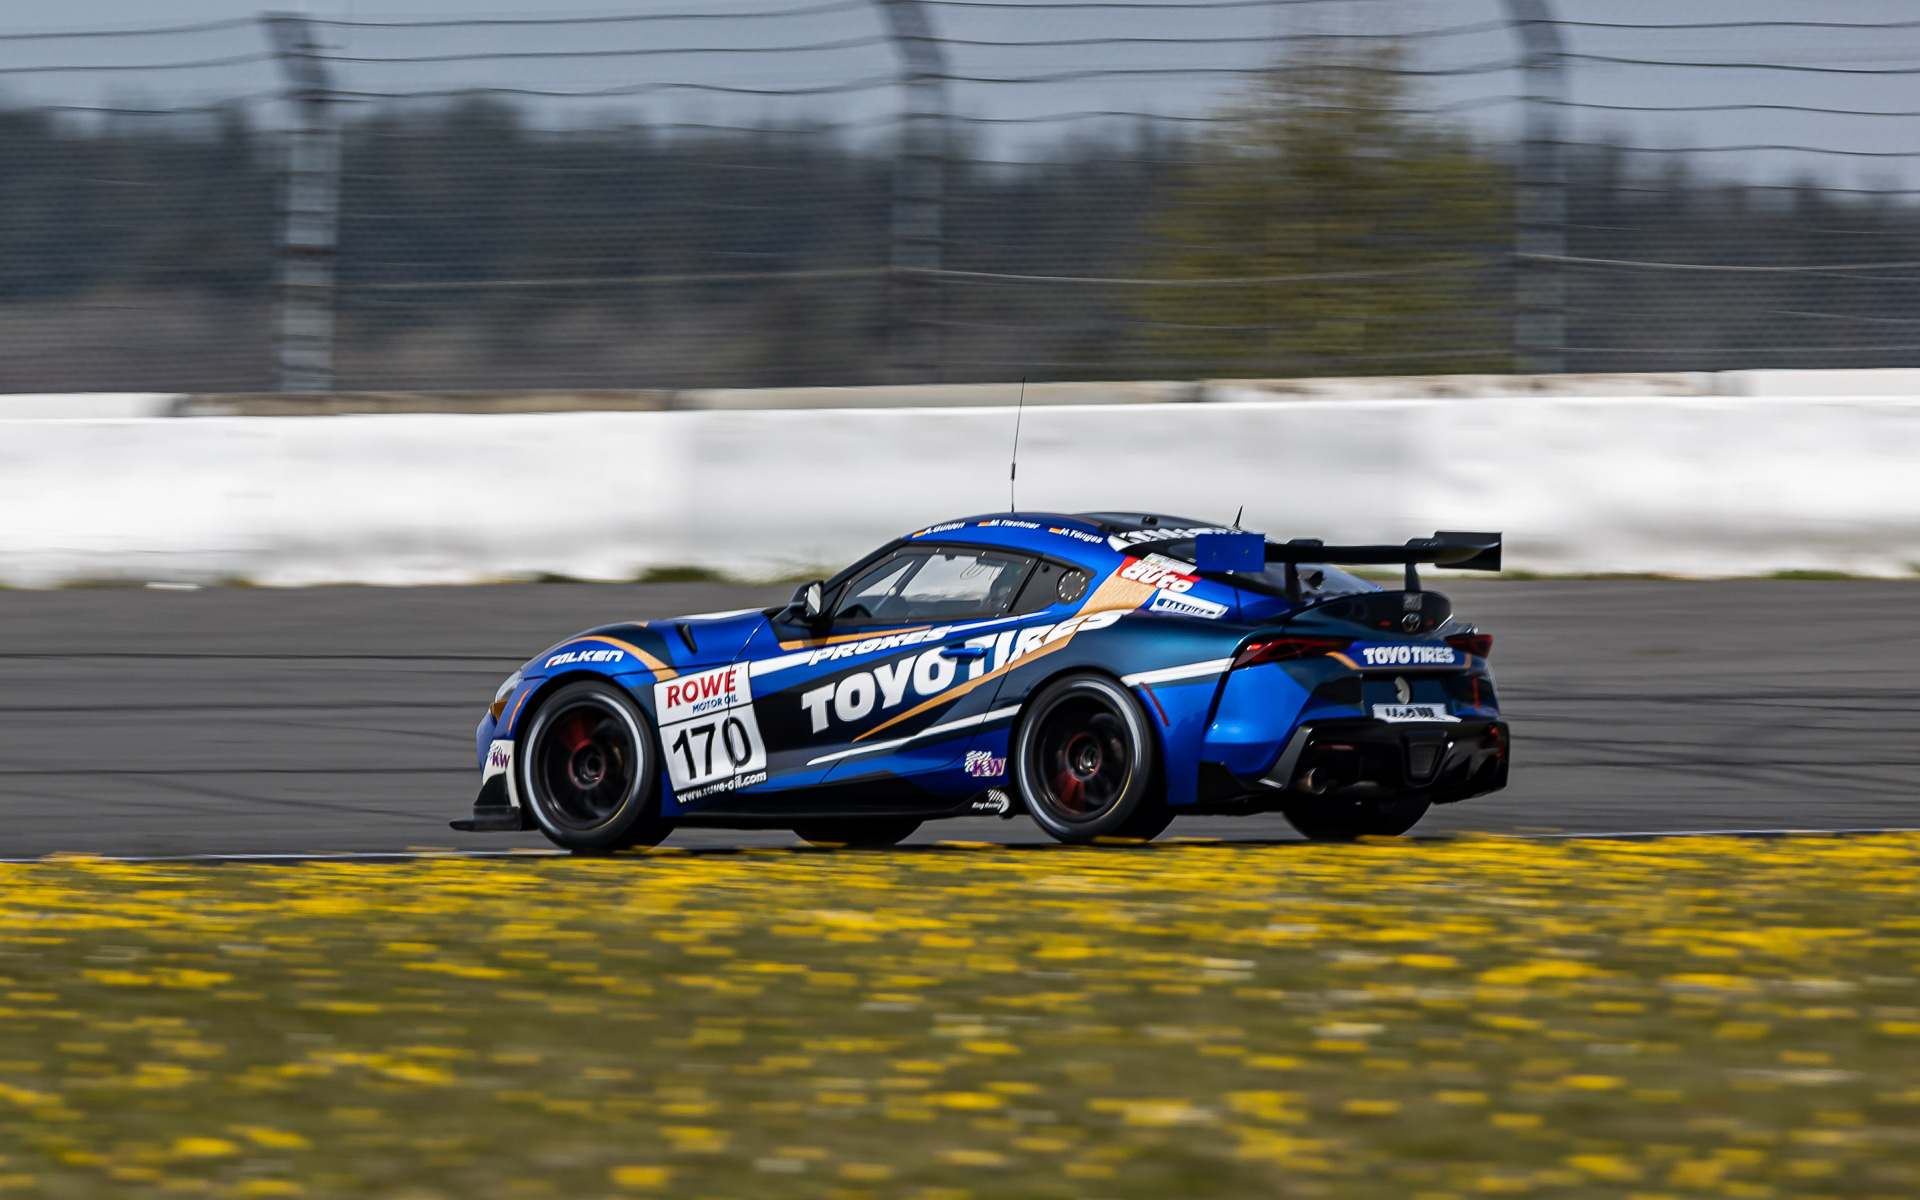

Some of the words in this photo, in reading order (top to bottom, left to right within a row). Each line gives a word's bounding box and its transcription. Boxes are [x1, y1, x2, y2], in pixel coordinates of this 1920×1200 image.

[544, 649, 624, 668] FALKEN
[808, 625, 953, 666] PROXES
[1363, 646, 1410, 664] TOYO
[1410, 646, 1455, 664] TIRES
[801, 645, 957, 734] TOYO
[963, 609, 1136, 681] TIRES
[666, 669, 737, 709] ROWE
[692, 698, 722, 714] MOTOR
[724, 694, 739, 706] OIL
[492, 752, 511, 769] KW
[672, 716, 754, 781] 170
[972, 758, 1007, 777] KW
[676, 771, 767, 804] www.rowe-oil.com
